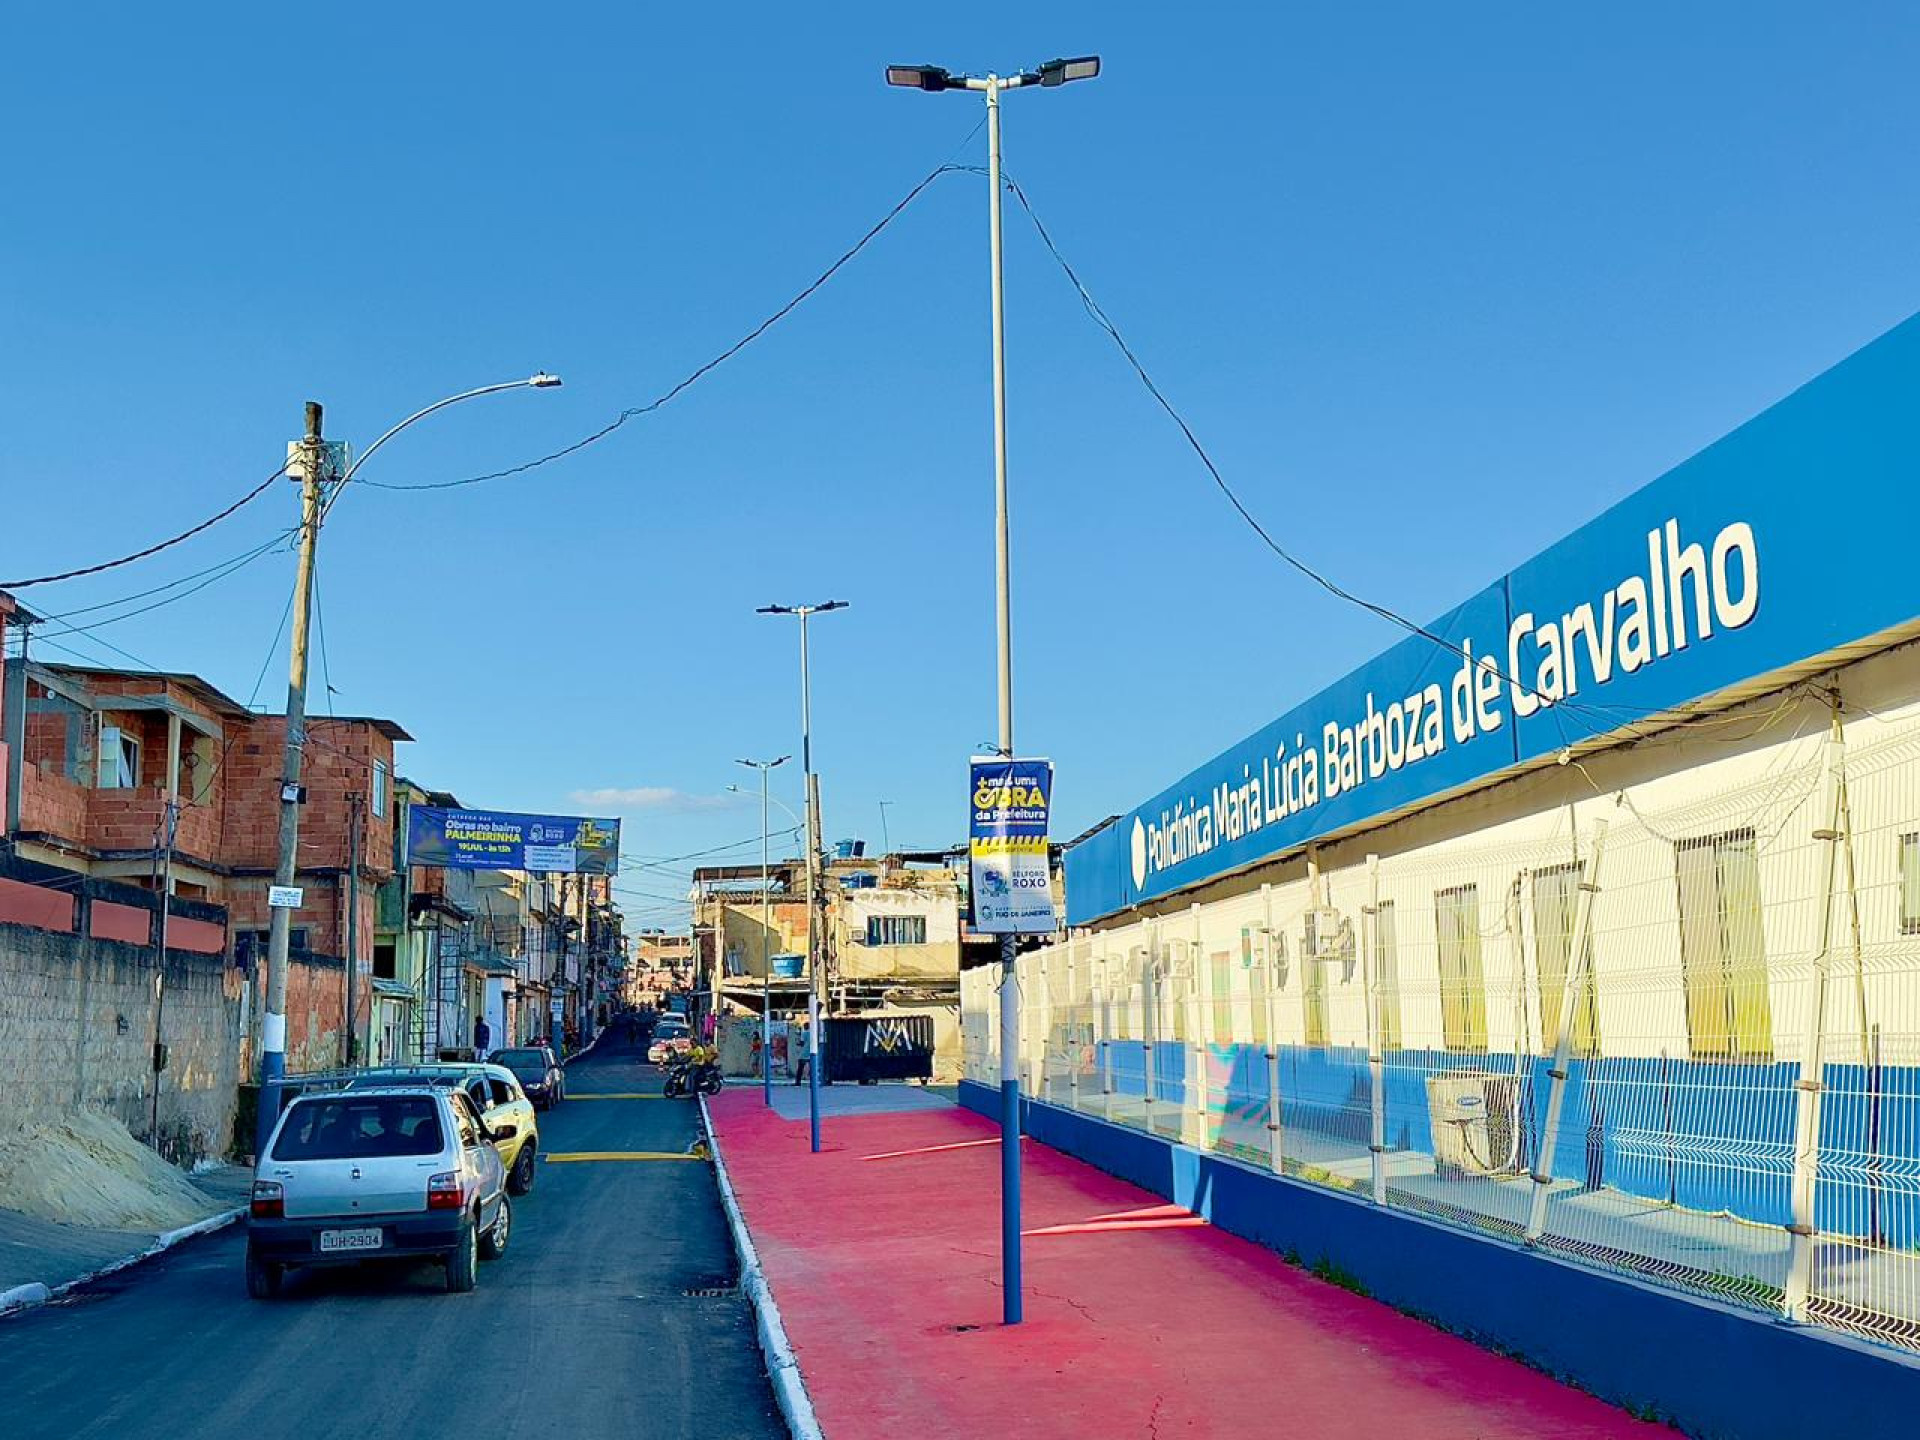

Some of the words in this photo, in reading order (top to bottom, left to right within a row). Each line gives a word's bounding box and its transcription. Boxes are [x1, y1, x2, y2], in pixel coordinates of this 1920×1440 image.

[1149, 796, 1212, 873] Policlínica
[1213, 764, 1262, 846] Maria
[1263, 732, 1319, 824] Lúcia
[1323, 692, 1445, 797] Barboza
[1451, 638, 1502, 743] de
[1509, 517, 1758, 716] Carvalho
[974, 787, 1046, 809] OBRA
[975, 809, 991, 820] da
[992, 808, 1046, 820] Prefeitura
[445, 819, 476, 831] Obras
[477, 822, 491, 831] no
[492, 821, 522, 833] bairro
[445, 829, 521, 843] PALMEIRINHA
[1012, 878, 1046, 888] ROXO
[1020, 909, 1051, 918] JANEIRO
